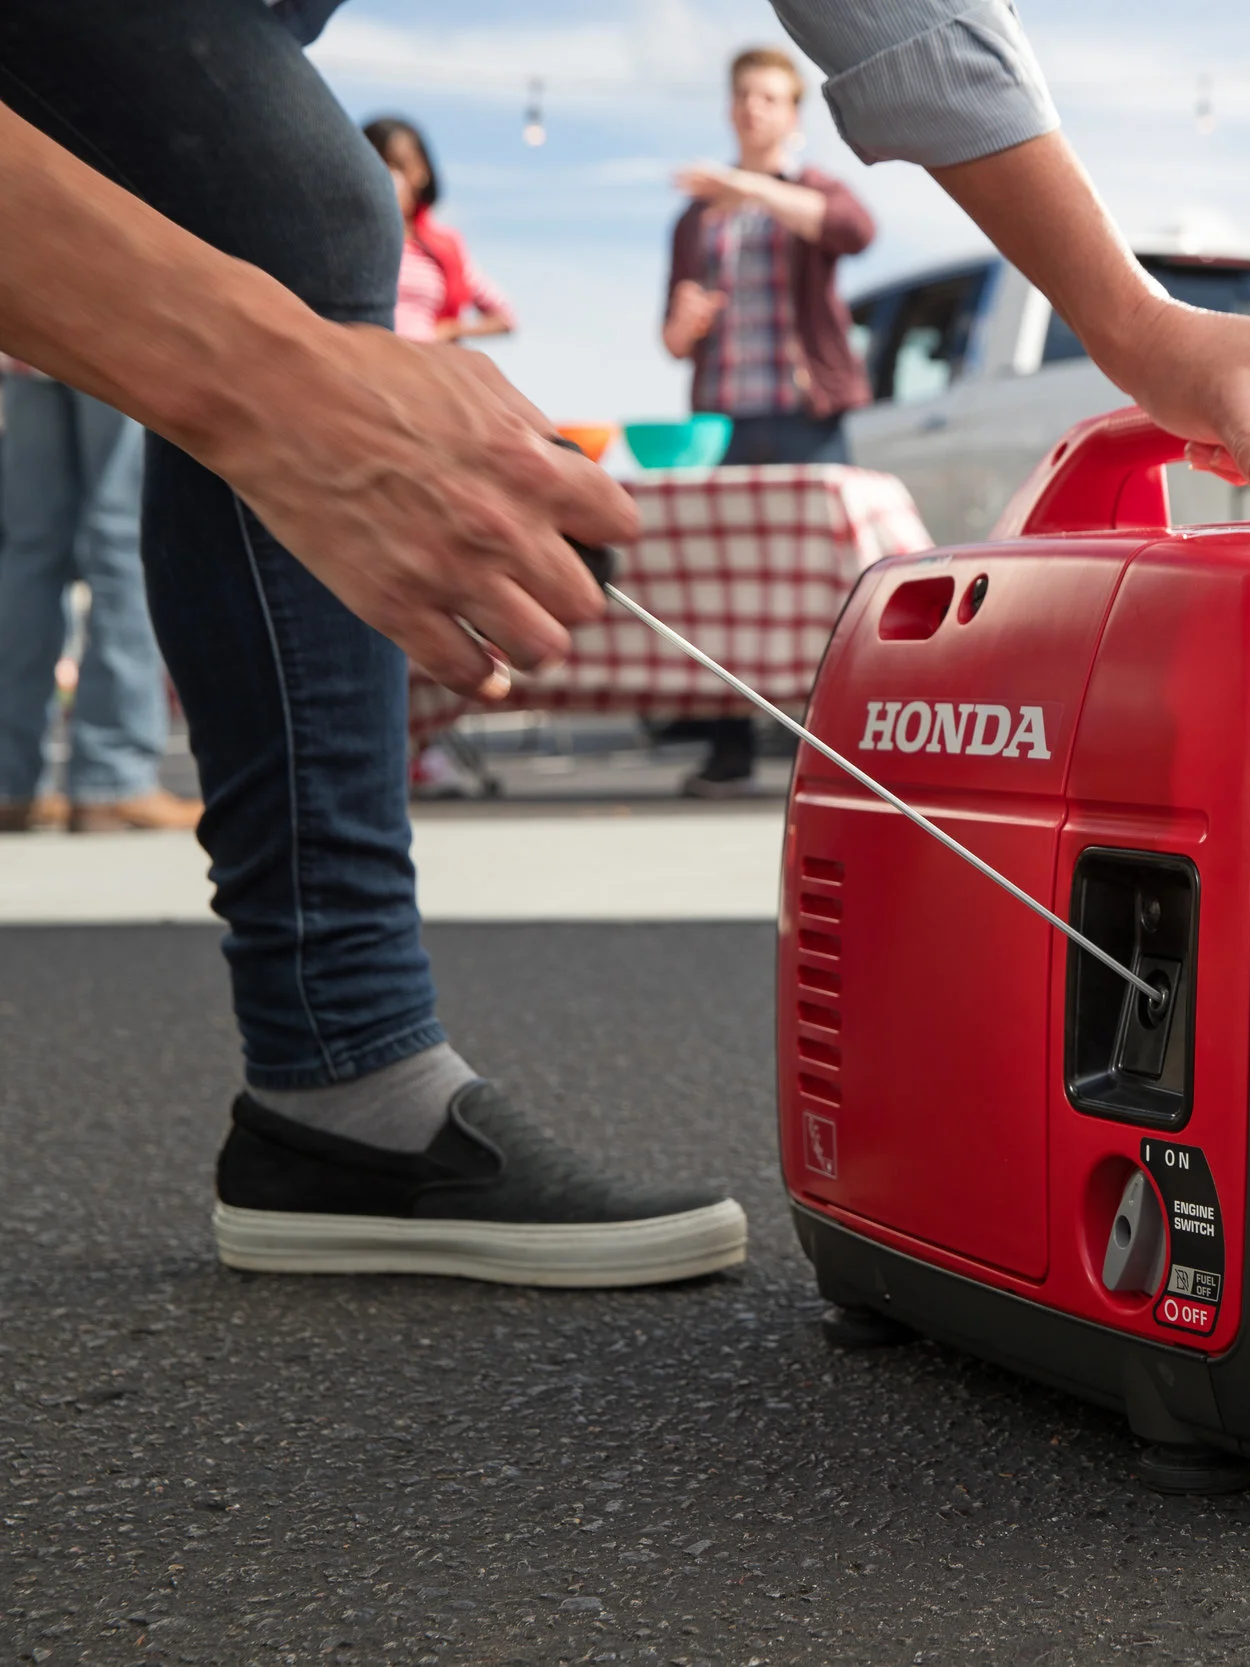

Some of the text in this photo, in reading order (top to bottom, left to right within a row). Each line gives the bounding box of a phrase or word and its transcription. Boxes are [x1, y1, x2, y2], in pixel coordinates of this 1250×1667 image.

[858, 701, 1051, 760] HONDA
[1165, 1149, 1190, 1170] ON
[1174, 1200, 1214, 1220] ENGINE
[1174, 1217, 1215, 1237] SWITCH
[1196, 1273, 1216, 1287] FUEL
[1196, 1285, 1212, 1297] OFF
[1181, 1306, 1208, 1326] OFF
